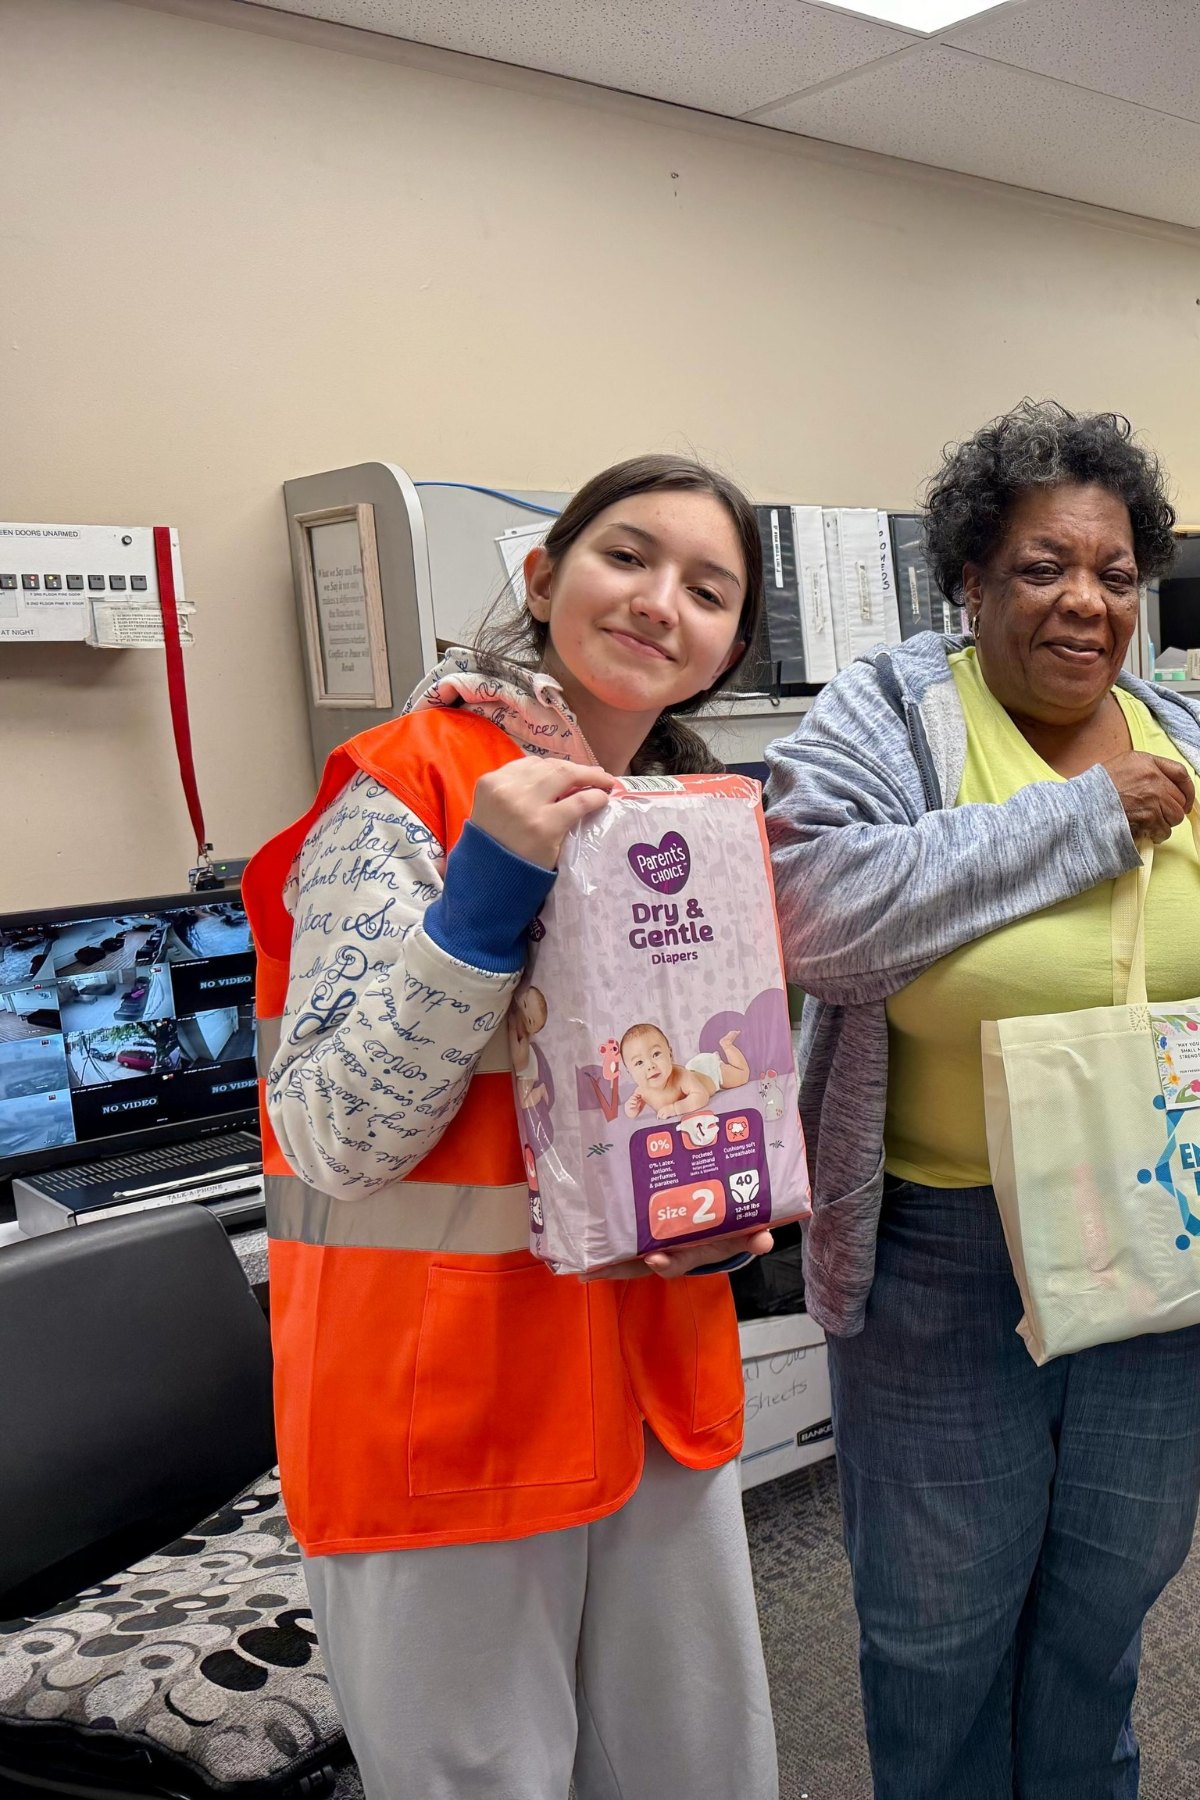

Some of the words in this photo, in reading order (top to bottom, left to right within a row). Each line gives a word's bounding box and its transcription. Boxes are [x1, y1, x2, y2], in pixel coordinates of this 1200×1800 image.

[636, 842, 686, 873] Parent's
[632, 902, 678, 927] Dry
[685, 898, 704, 919] &
[628, 921, 714, 950] Gentle
[651, 950, 698, 965] Diapers
[200, 980, 215, 990] NO
[220, 976, 251, 986] VIDEO
[212, 1084, 227, 1093] NO
[102, 1105, 119, 1114] NO
[123, 1098, 157, 1110] VIDEO
[650, 1139, 670, 1152] 0%
[724, 1145, 745, 1153] Cushiony
[730, 1148, 756, 1158] breathable
[651, 1173, 676, 1182] perfumes
[654, 1179, 679, 1188] parabens
[736, 1174, 752, 1186] 40
[167, 1184, 223, 1200] TALK-A-PHONE
[656, 1204, 687, 1221] Size
[691, 1188, 716, 1224] 2
[736, 1210, 758, 1220] (5-8kg)
[745, 1378, 808, 1421] Sheets
